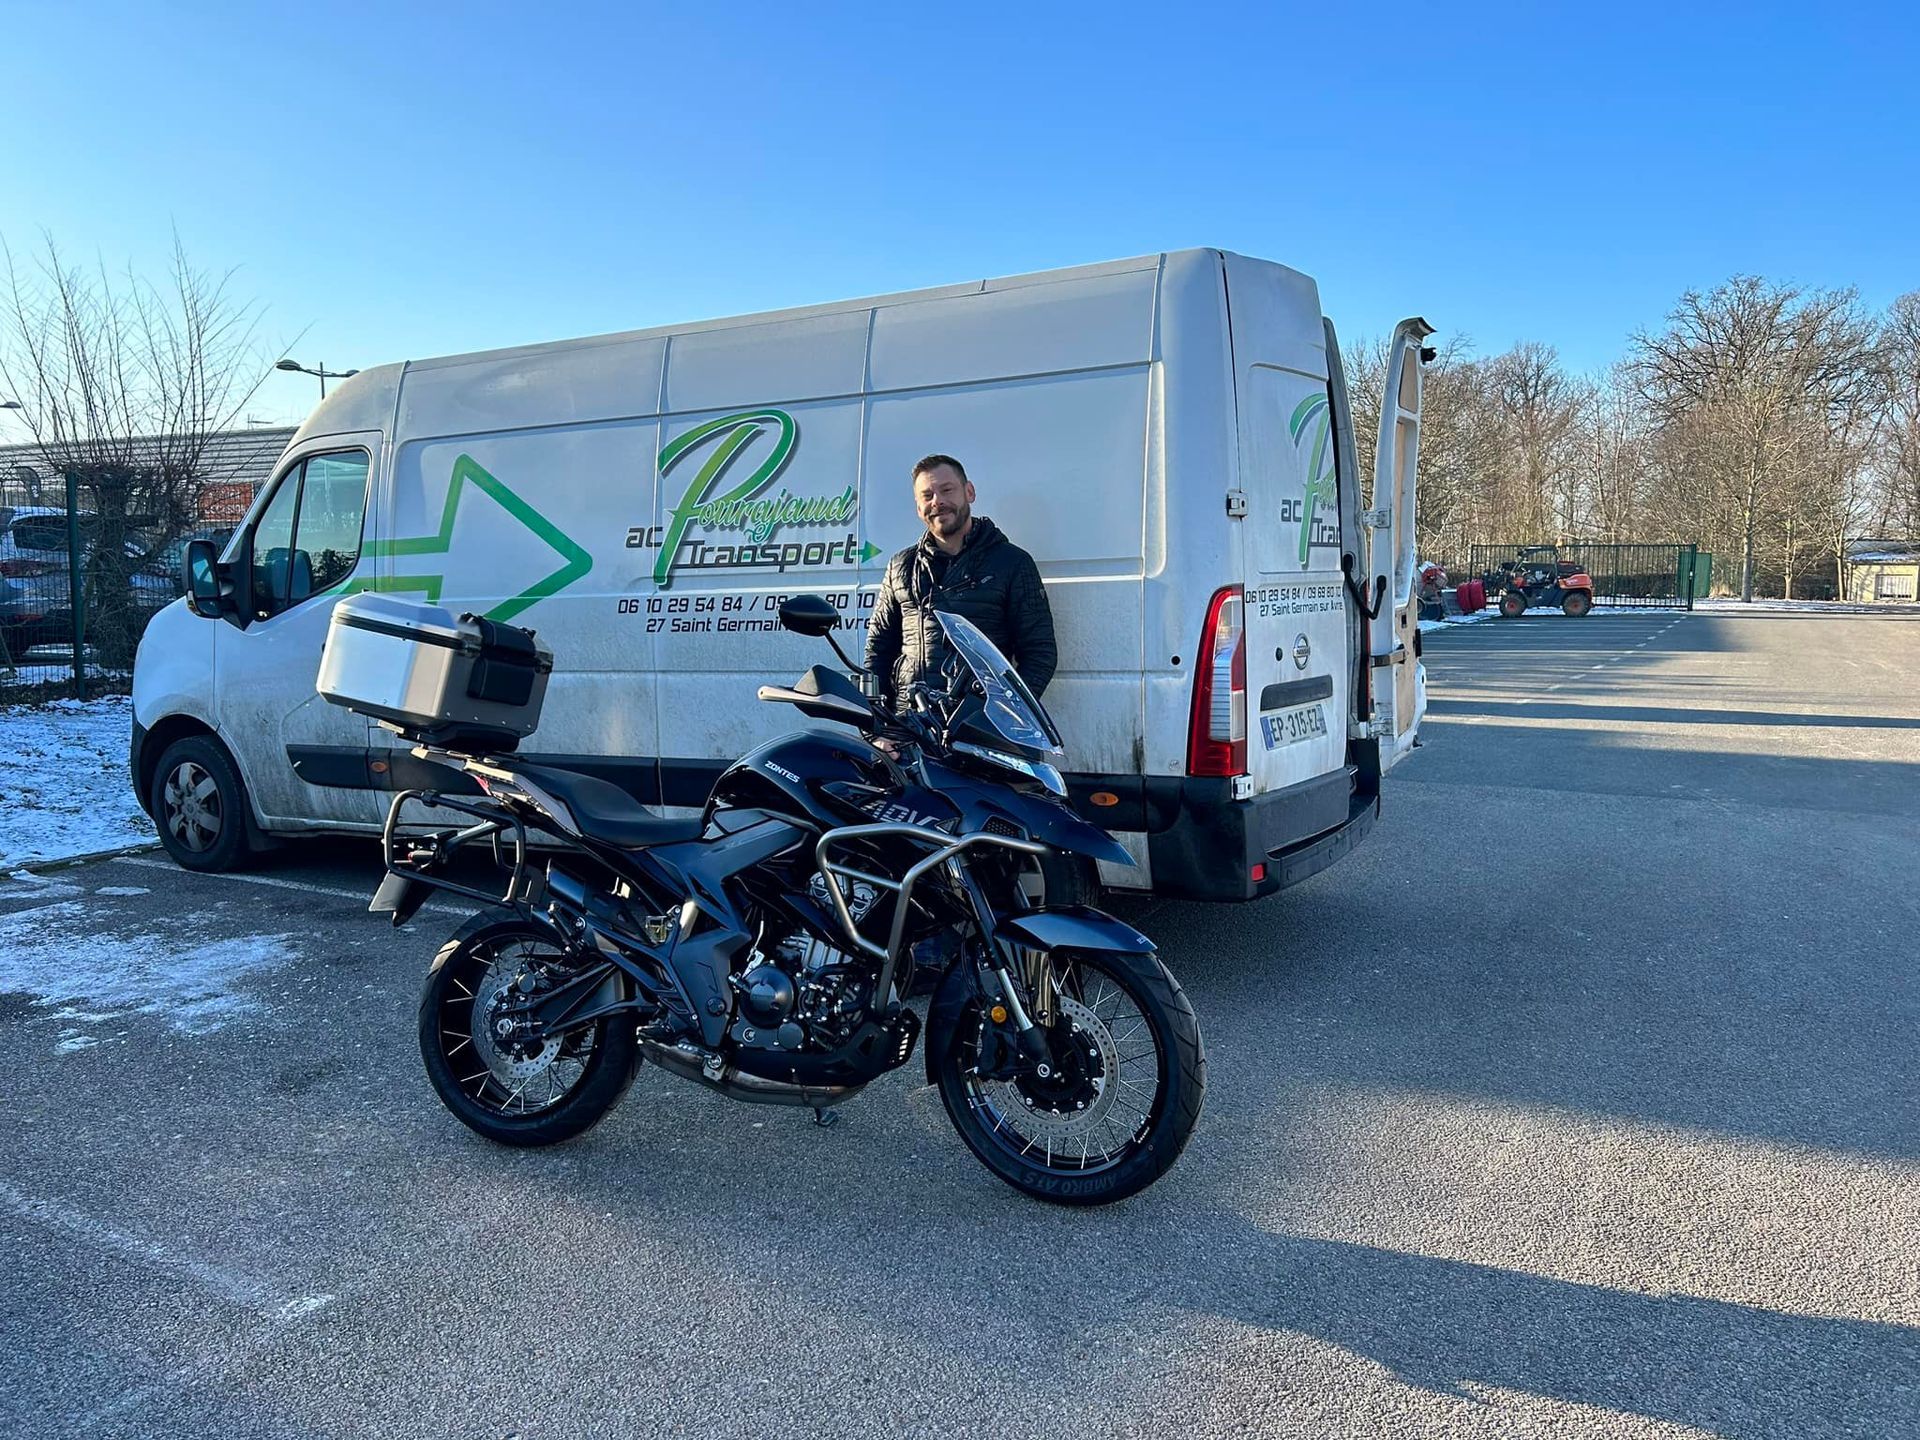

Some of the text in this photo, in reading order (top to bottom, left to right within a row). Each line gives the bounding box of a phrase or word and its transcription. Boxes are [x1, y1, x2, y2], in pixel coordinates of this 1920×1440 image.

[1281, 499, 1302, 522] ac
[626, 526, 857, 573] ac Transport
[618, 599, 640, 614] 06
[646, 598, 663, 613] 10
[667, 597, 690, 613] 29
[694, 596, 716, 612] 54
[721, 595, 743, 612] 84
[857, 593, 876, 609] 10
[1245, 590, 1257, 604] 06
[1258, 589, 1267, 603] 10
[1268, 588, 1279, 602] 29
[1280, 588, 1290, 601] 54
[1291, 587, 1301, 600] 84
[1260, 604, 1269, 617] 27
[1271, 603, 1290, 616] Saint
[646, 617, 667, 633] 27
[670, 617, 713, 633] Saint
[764, 760, 801, 783] ZONTES
